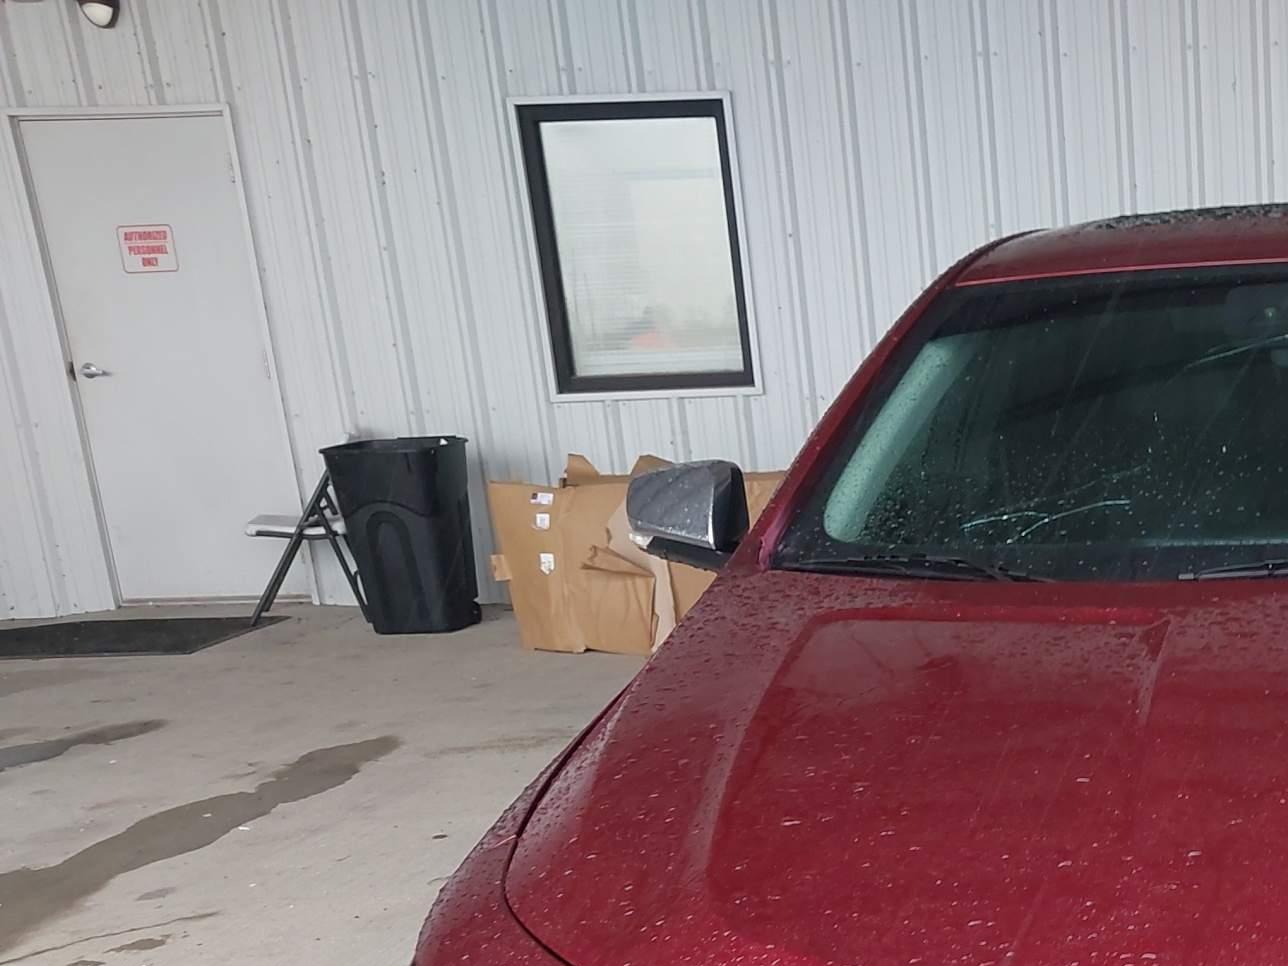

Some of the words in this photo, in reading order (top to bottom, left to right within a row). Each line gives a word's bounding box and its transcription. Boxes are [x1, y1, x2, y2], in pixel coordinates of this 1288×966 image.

[124, 230, 168, 241] AUTHORIZED
[128, 244, 169, 255] PERSONNEL
[142, 257, 159, 267] ONLY
